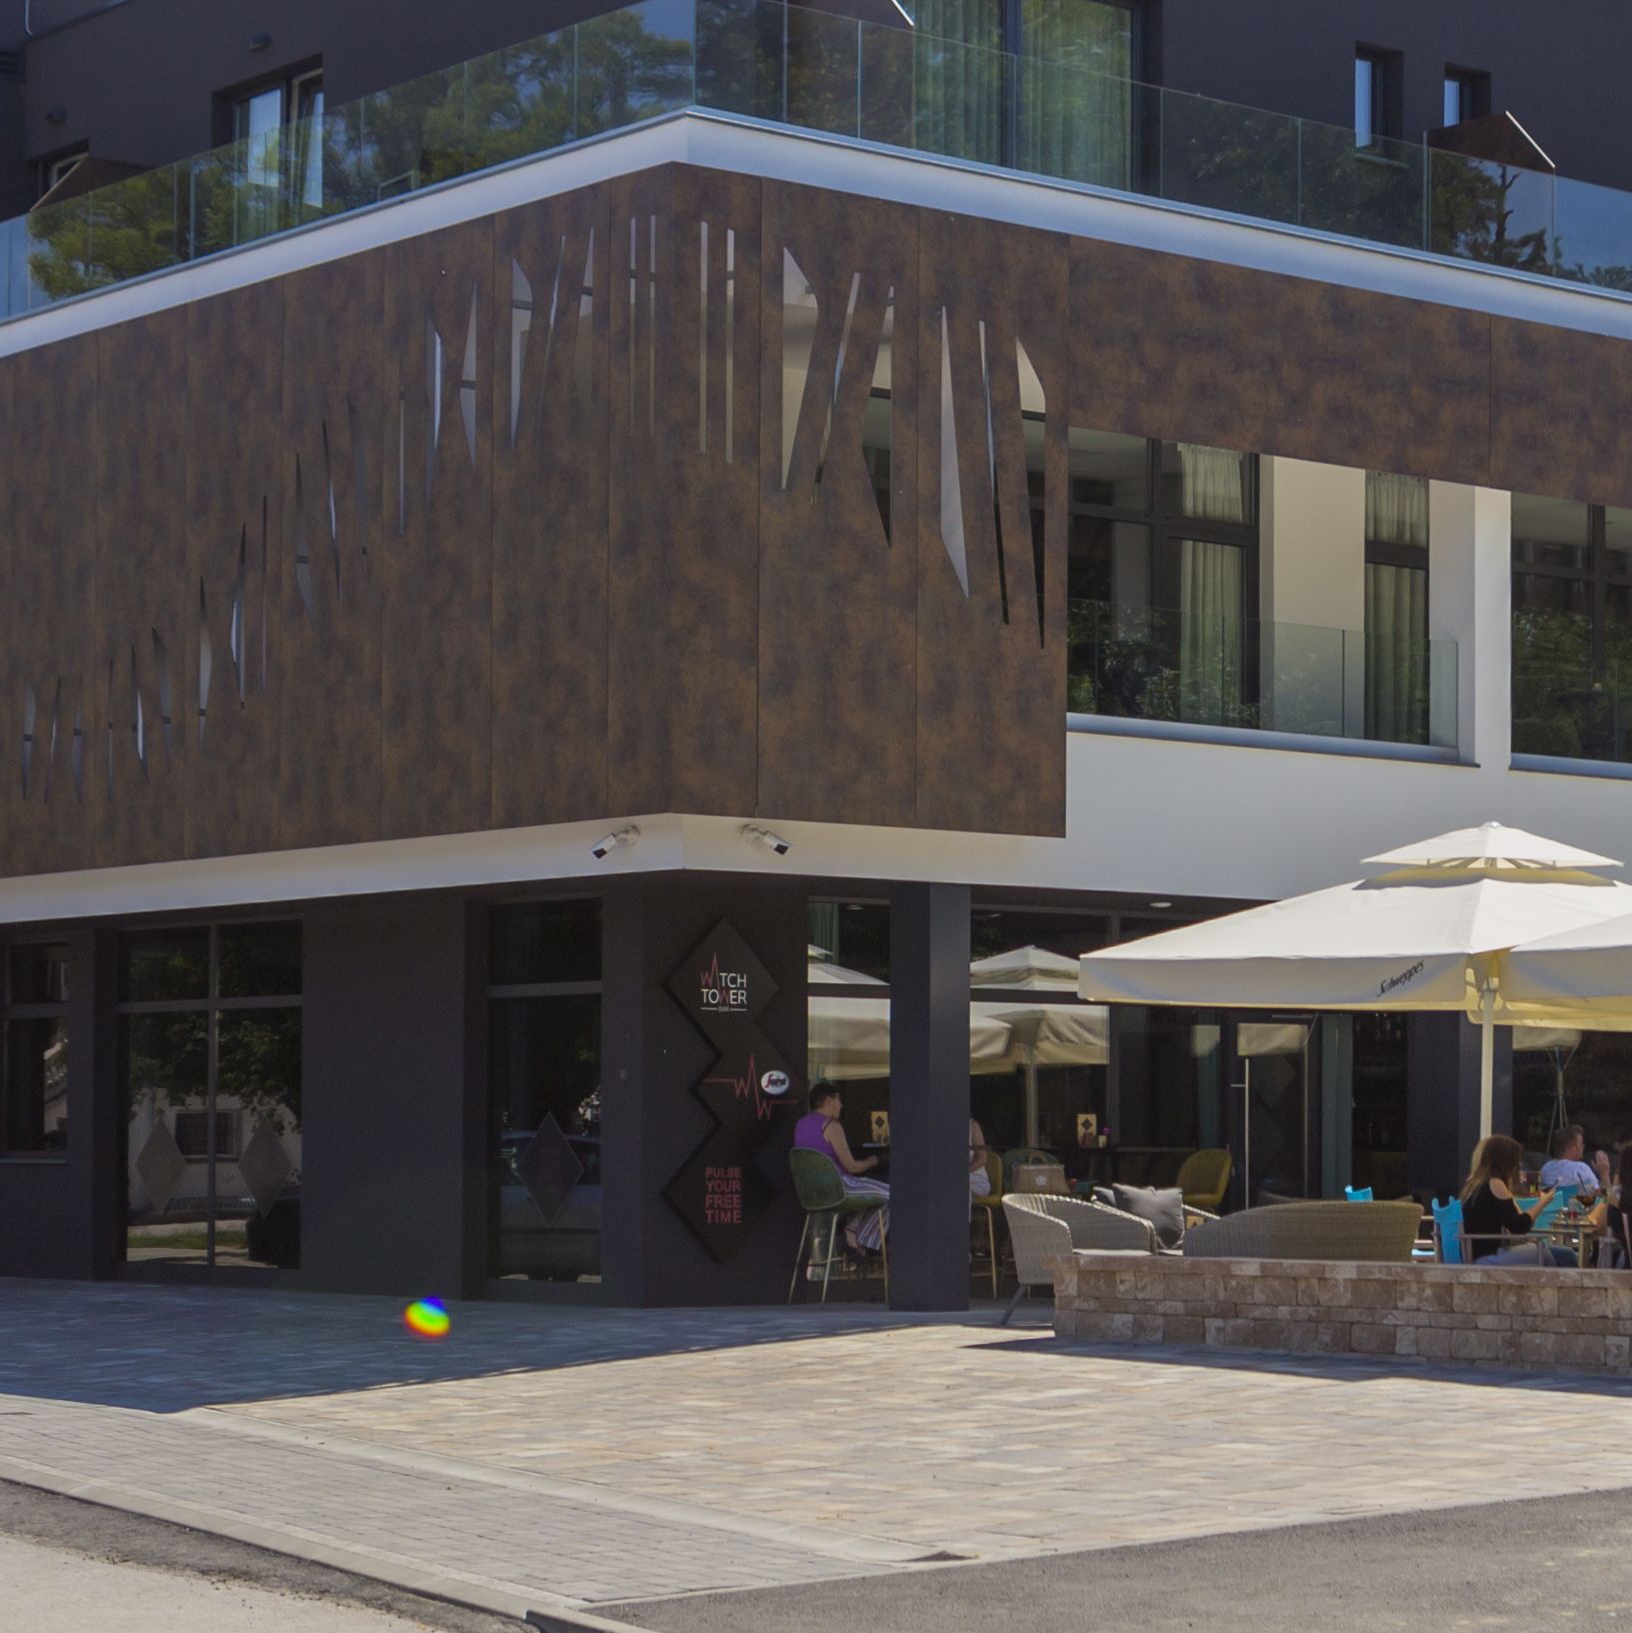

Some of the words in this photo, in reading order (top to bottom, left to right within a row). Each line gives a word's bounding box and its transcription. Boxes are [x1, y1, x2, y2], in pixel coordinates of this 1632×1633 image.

[700, 952, 747, 987] WATCH
[700, 988, 748, 1005] TOWER
[705, 1179, 742, 1193] YOUR
[705, 1194, 742, 1208] FREE
[705, 1209, 742, 1224] TIME
